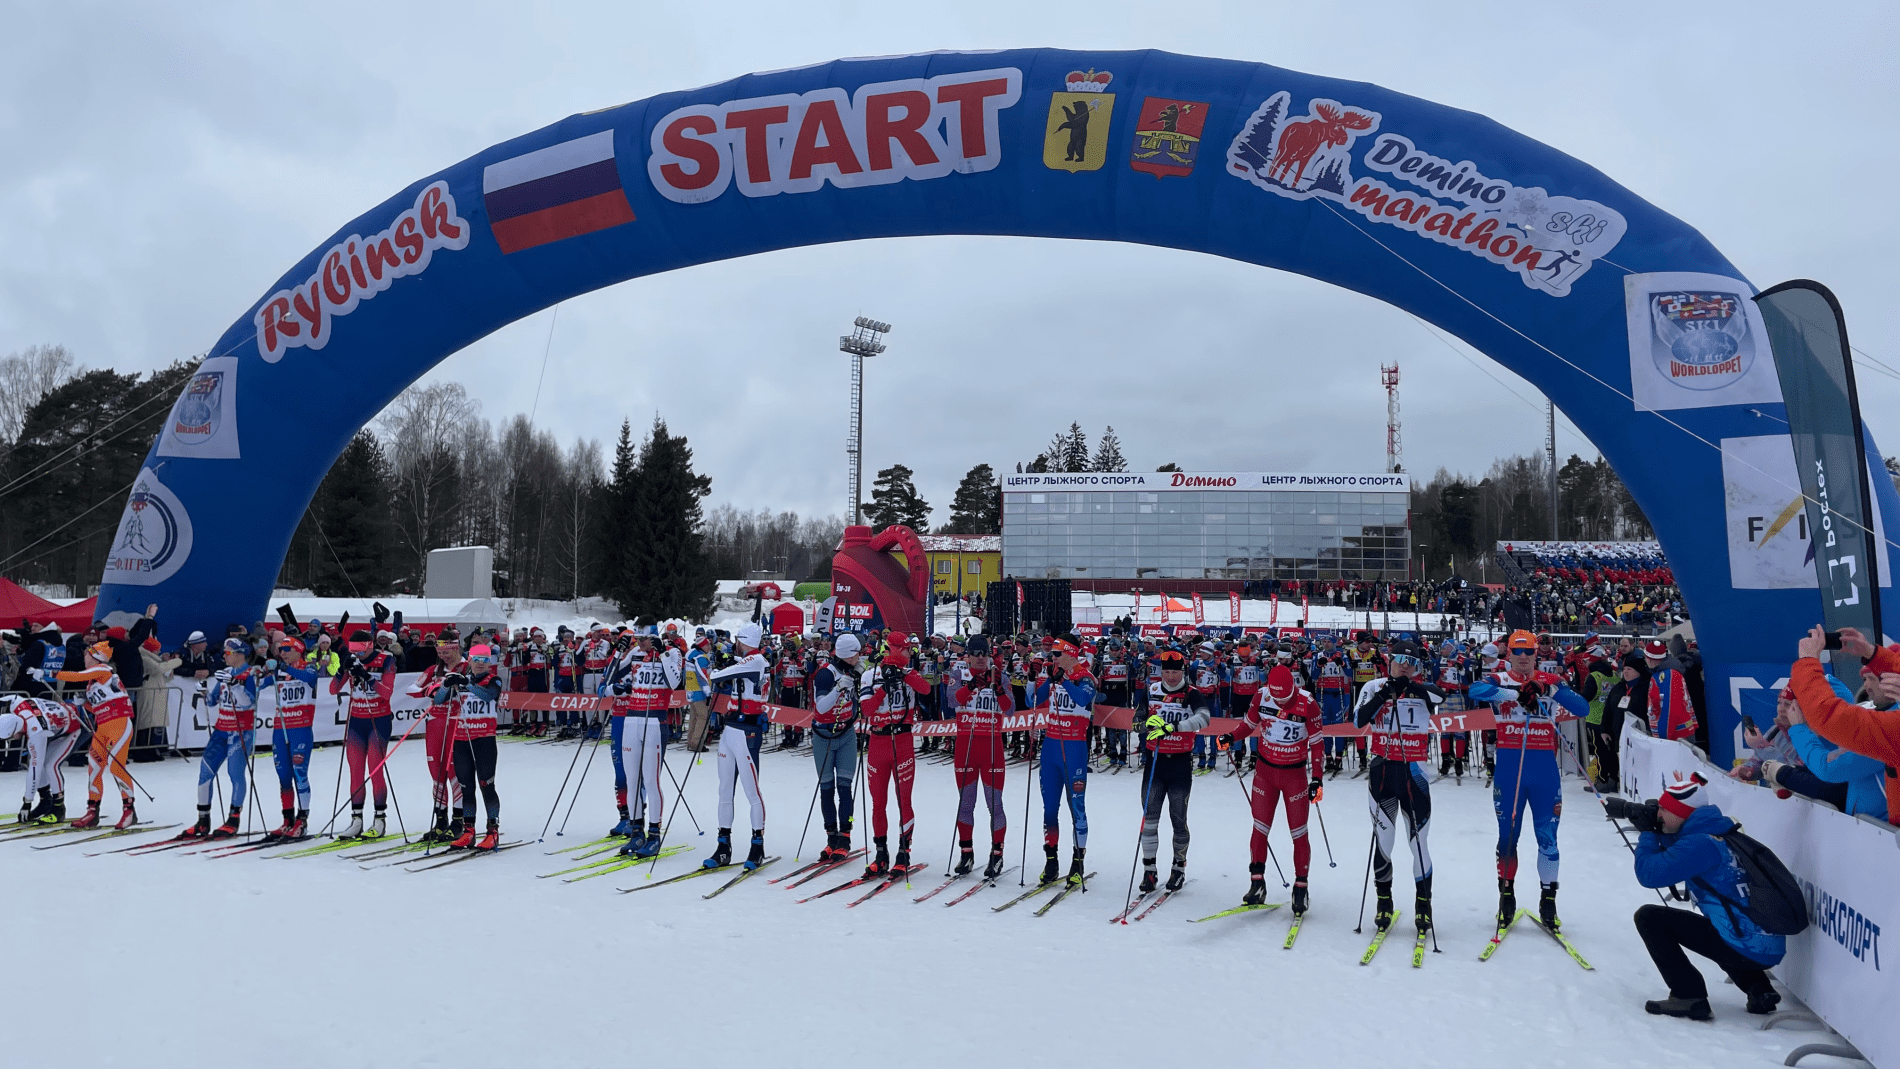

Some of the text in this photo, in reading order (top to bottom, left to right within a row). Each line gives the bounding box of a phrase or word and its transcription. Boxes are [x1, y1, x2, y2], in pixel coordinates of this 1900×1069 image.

[660, 78, 1008, 190] START
[1372, 139, 1506, 203] Demino
[1350, 184, 1543, 271] marathon
[1546, 212, 1608, 245] ski
[261, 187, 460, 352] Rybinsk
[1685, 320, 1719, 331] SKI
[1670, 355, 1742, 377] WORLDLOPPET
[1007, 476, 1145, 486] ЦЕНТР ЛЫЖНОГО СПОРТА
[1170, 473, 1237, 487] Демино
[1262, 475, 1403, 486] ЦЕНТР ЛЫЖНОГО СПОРТА
[638, 671, 665, 685] 3022
[1244, 671, 1255, 680] 121
[282, 687, 306, 701] 3009
[466, 700, 491, 714] 3021
[550, 696, 600, 709] СТАРТ
[1406, 707, 1414, 724] 1
[1283, 726, 1300, 740] 25
[1504, 724, 1551, 737] Демино
